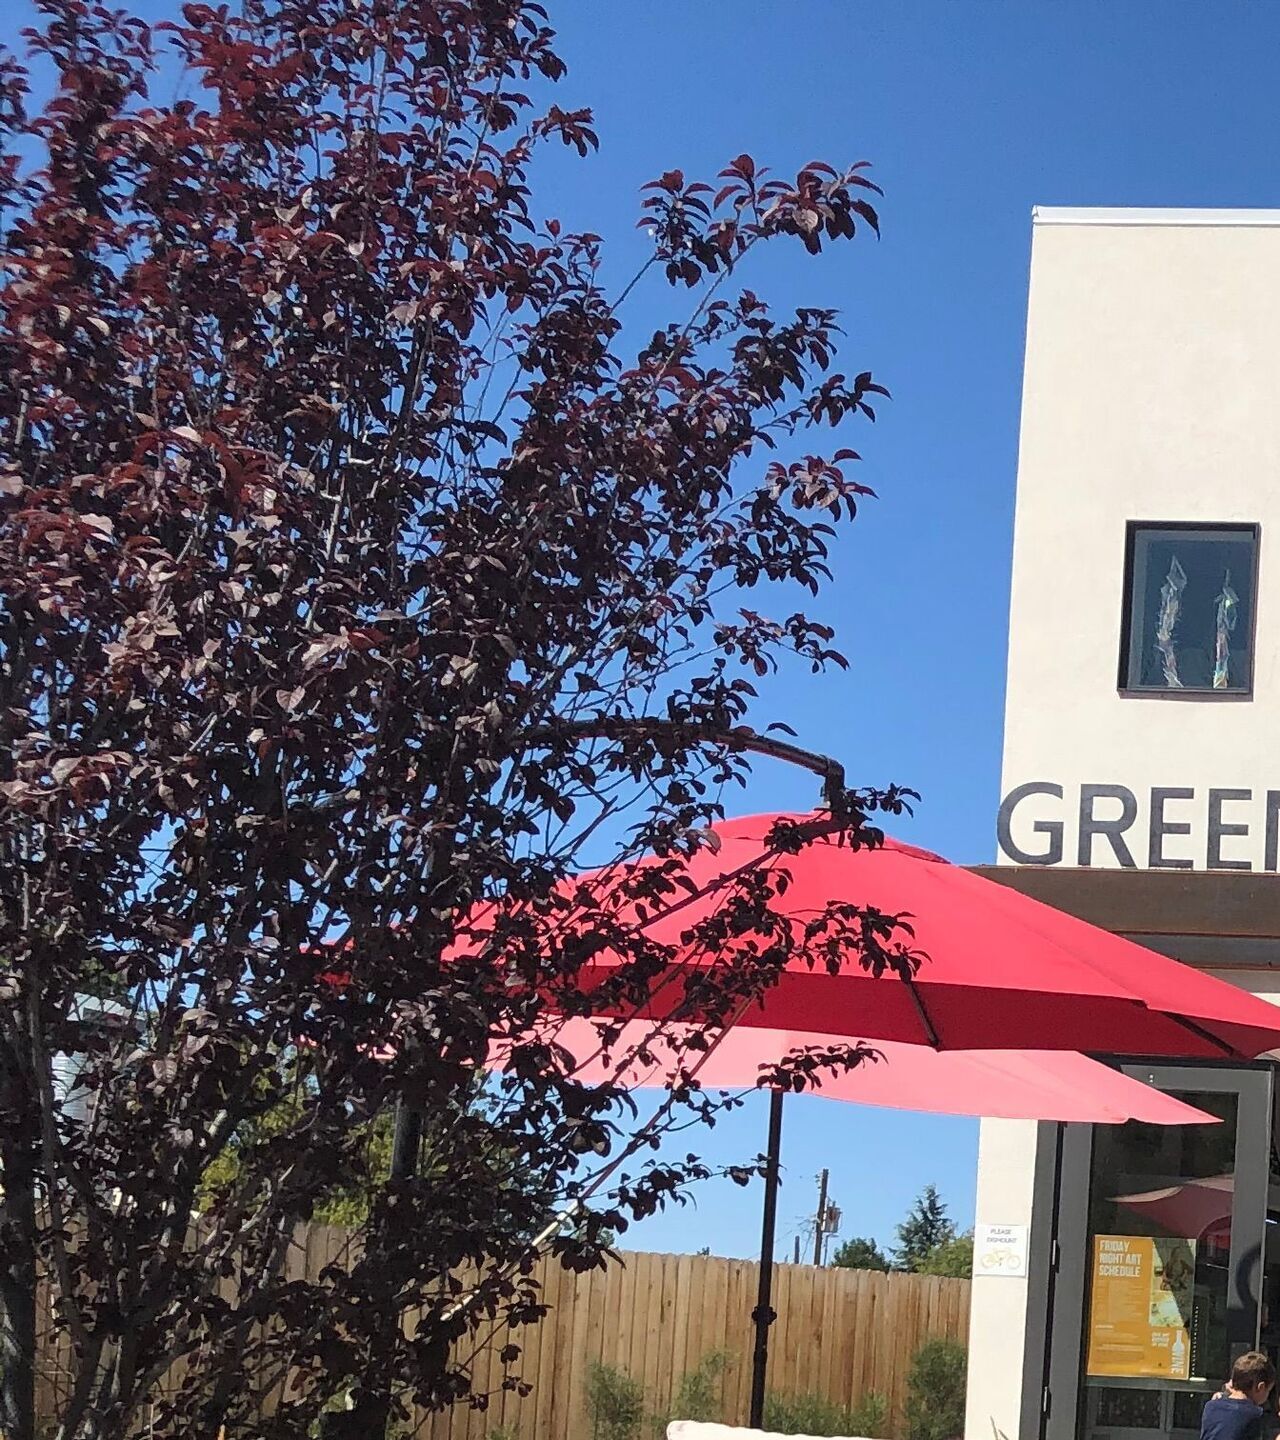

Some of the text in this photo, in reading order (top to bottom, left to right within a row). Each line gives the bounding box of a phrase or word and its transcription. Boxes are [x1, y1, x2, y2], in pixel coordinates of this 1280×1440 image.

[1100, 1240, 1131, 1252] FRIDAY
[1100, 1252, 1142, 1265] NIGHT ART
[1099, 1264, 1140, 1277] SCHEDULE
